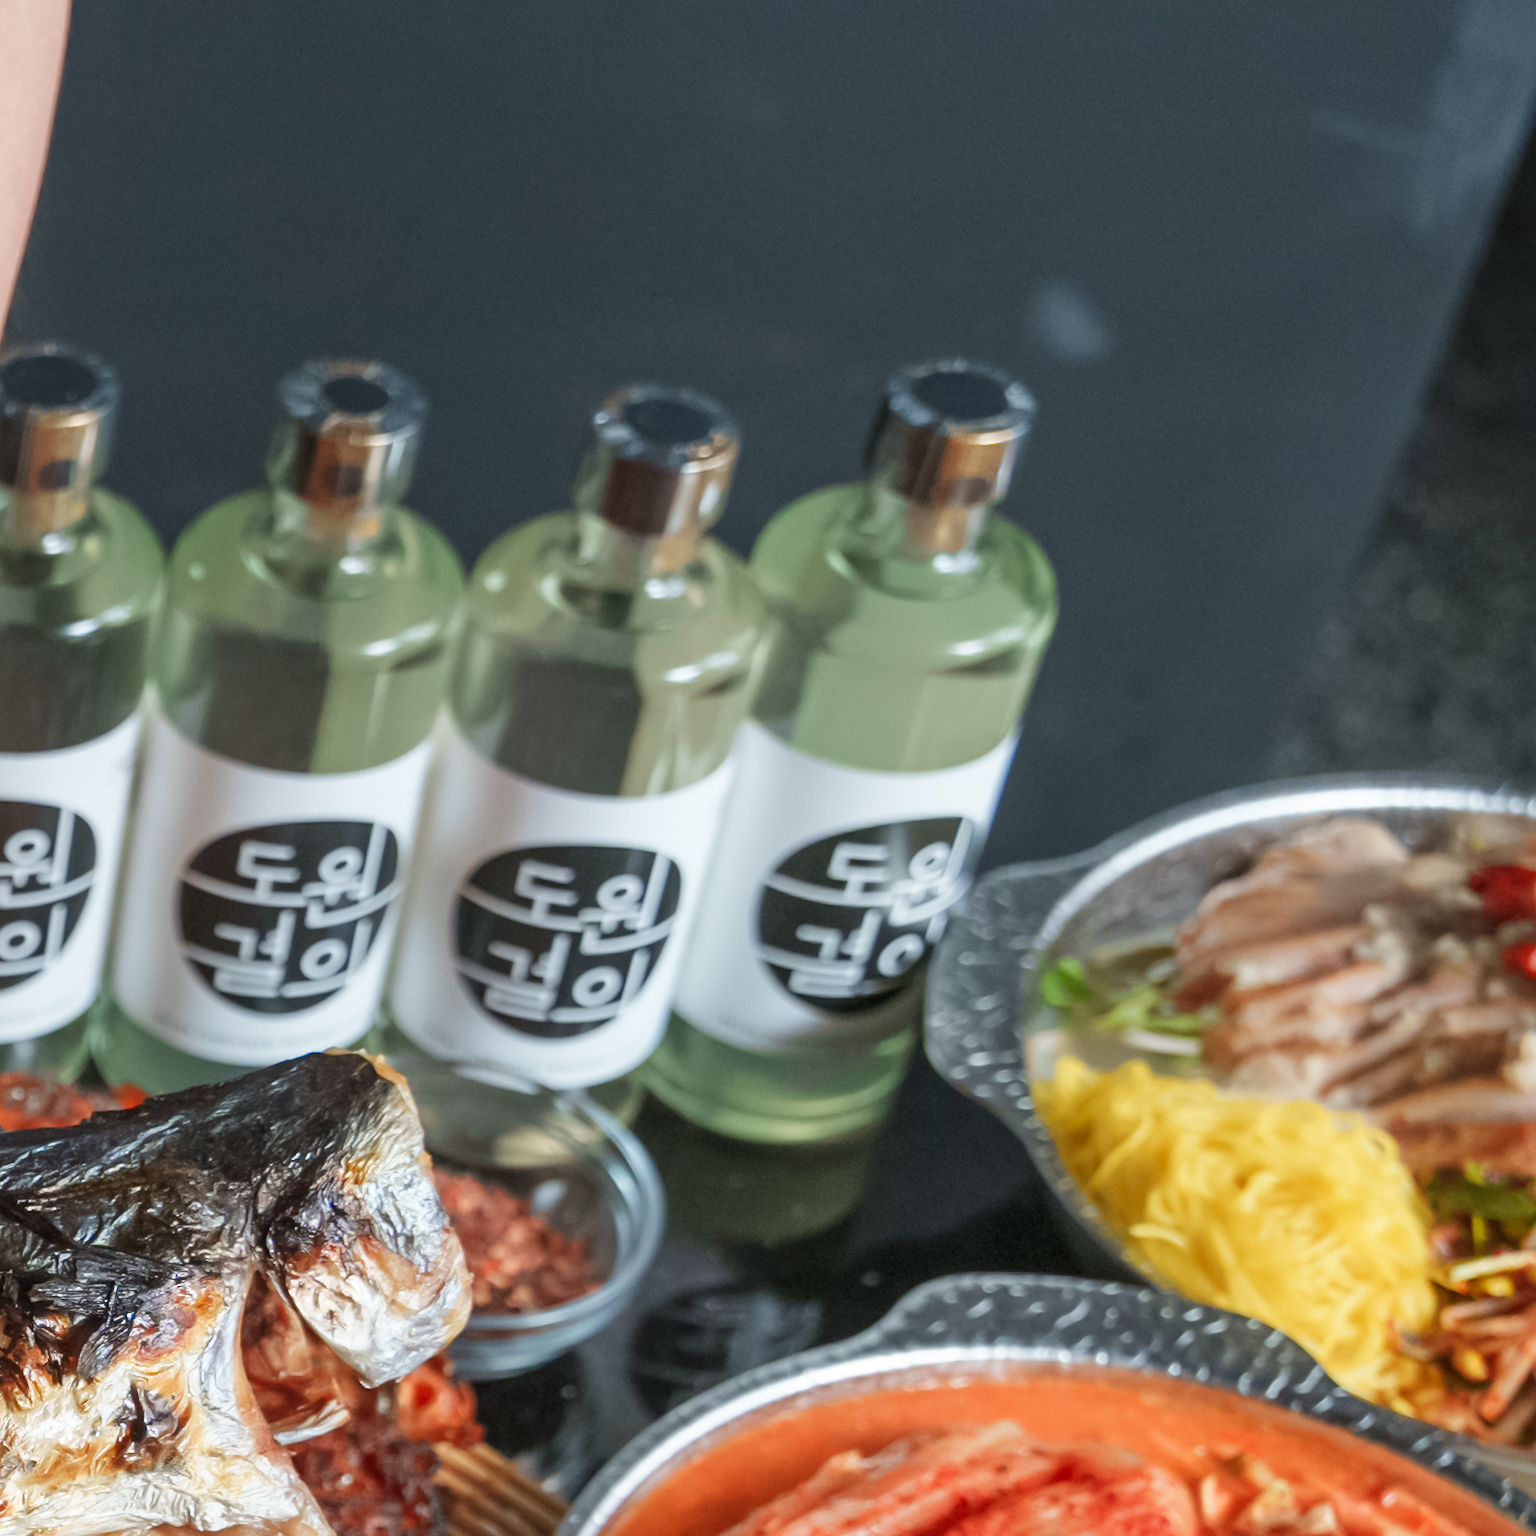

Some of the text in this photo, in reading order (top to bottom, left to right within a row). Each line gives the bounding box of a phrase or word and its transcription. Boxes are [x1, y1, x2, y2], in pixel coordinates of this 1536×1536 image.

[182, 823, 400, 929] 도원
[460, 853, 679, 953] 도원
[766, 817, 974, 926] 도원
[184, 908, 372, 999] 결의
[457, 933, 650, 1023] 결의
